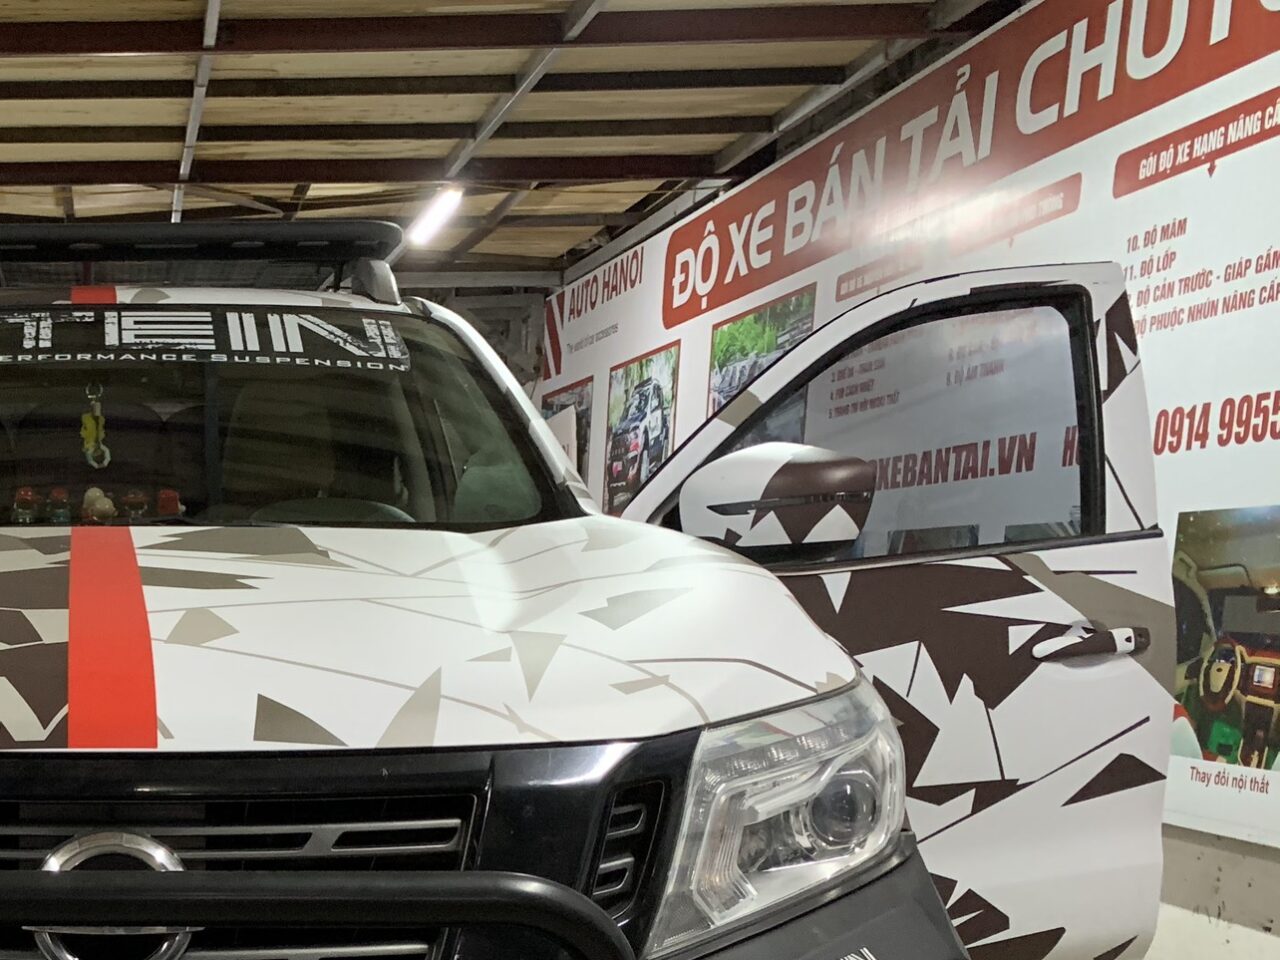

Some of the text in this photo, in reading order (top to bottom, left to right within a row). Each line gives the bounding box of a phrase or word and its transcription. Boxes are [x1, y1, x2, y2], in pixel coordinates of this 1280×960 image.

[1175, 139, 1192, 166] XE
[1226, 113, 1263, 146] NÂNG
[672, 220, 720, 310] ĐỘ
[724, 200, 776, 285] XE
[784, 141, 886, 256] BÁN
[900, 64, 1000, 198] TẢI
[1126, 234, 1141, 254] 10.
[568, 246, 644, 323] AUTO HANOI
[211, 353, 408, 372] SUSPENSION
[1153, 402, 1212, 456] 0914
[1190, 766, 1212, 788] Thay
